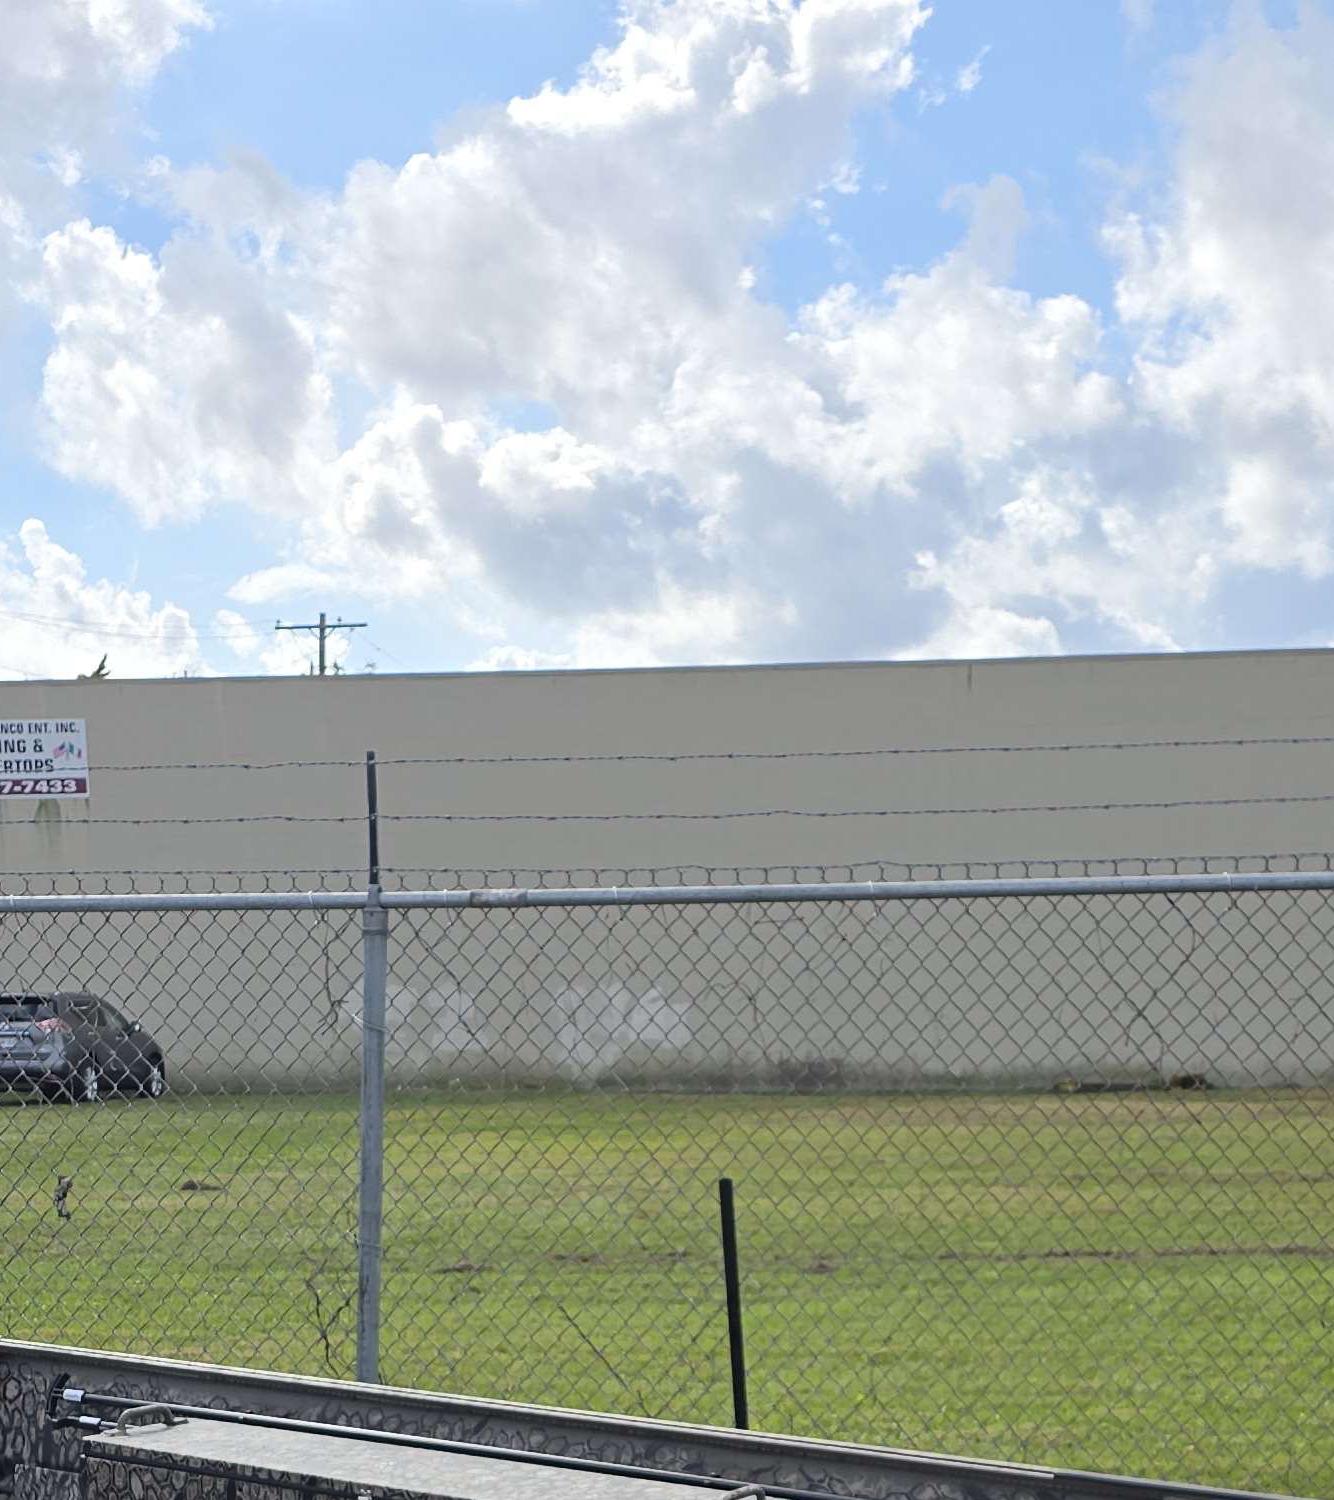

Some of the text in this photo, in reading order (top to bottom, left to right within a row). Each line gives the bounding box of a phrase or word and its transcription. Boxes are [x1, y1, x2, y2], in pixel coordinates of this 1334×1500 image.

[28, 721, 52, 734] ENT.
[55, 721, 80, 734] INC.
[33, 738, 44, 753] &
